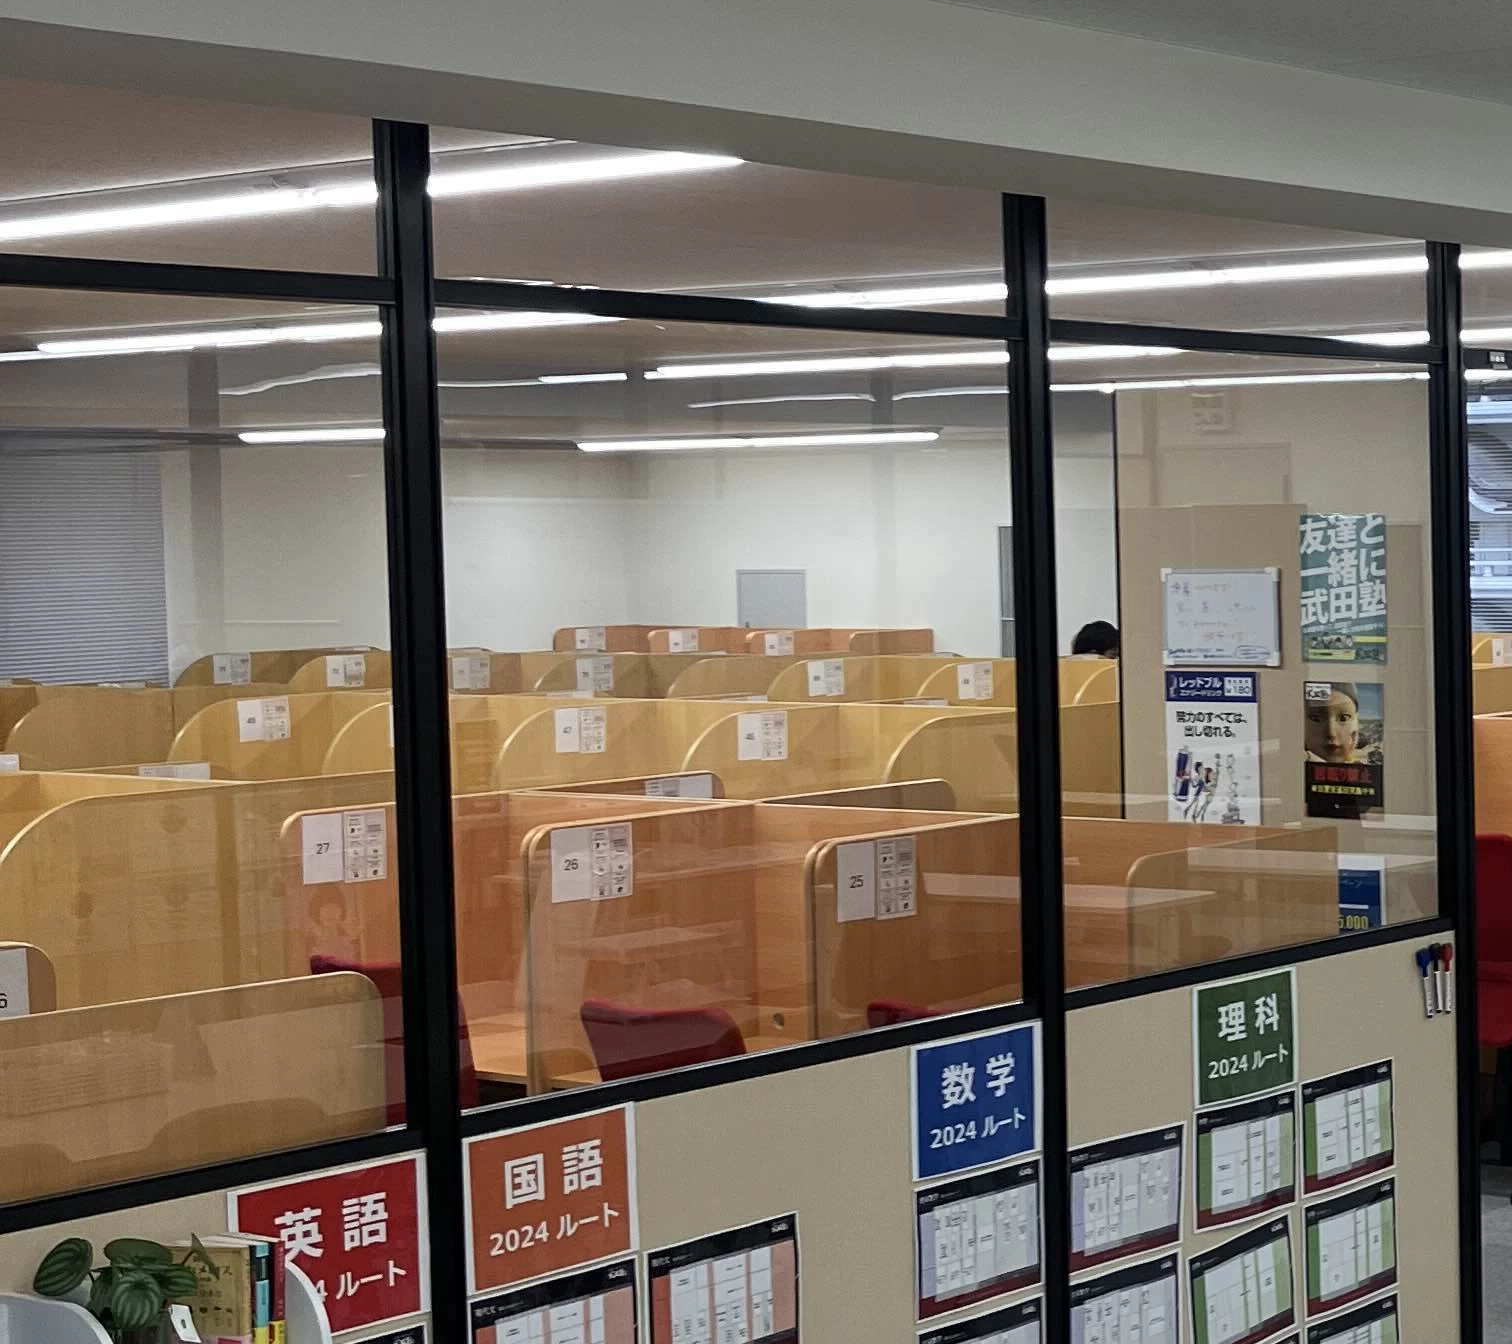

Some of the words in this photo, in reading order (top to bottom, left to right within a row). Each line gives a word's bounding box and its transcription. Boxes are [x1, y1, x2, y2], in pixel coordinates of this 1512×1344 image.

[1300, 548, 1386, 587] 一緒に
[1301, 580, 1387, 626] 武田塾
[316, 842, 331, 855] 27
[850, 874, 864, 889] 25
[1217, 992, 1280, 1042] 理科
[941, 1051, 1016, 1110] 数学
[1208, 1054, 1249, 1079] 2024
[1251, 1043, 1289, 1070] ルート
[929, 1120, 977, 1149] 2024
[980, 1107, 1026, 1138] ルート
[504, 1139, 603, 1210] 国語
[274, 1191, 390, 1263] 英語
[489, 1221, 550, 1256] 2024
[555, 1202, 620, 1240] ルート
[335, 1259, 408, 1300] ルート
